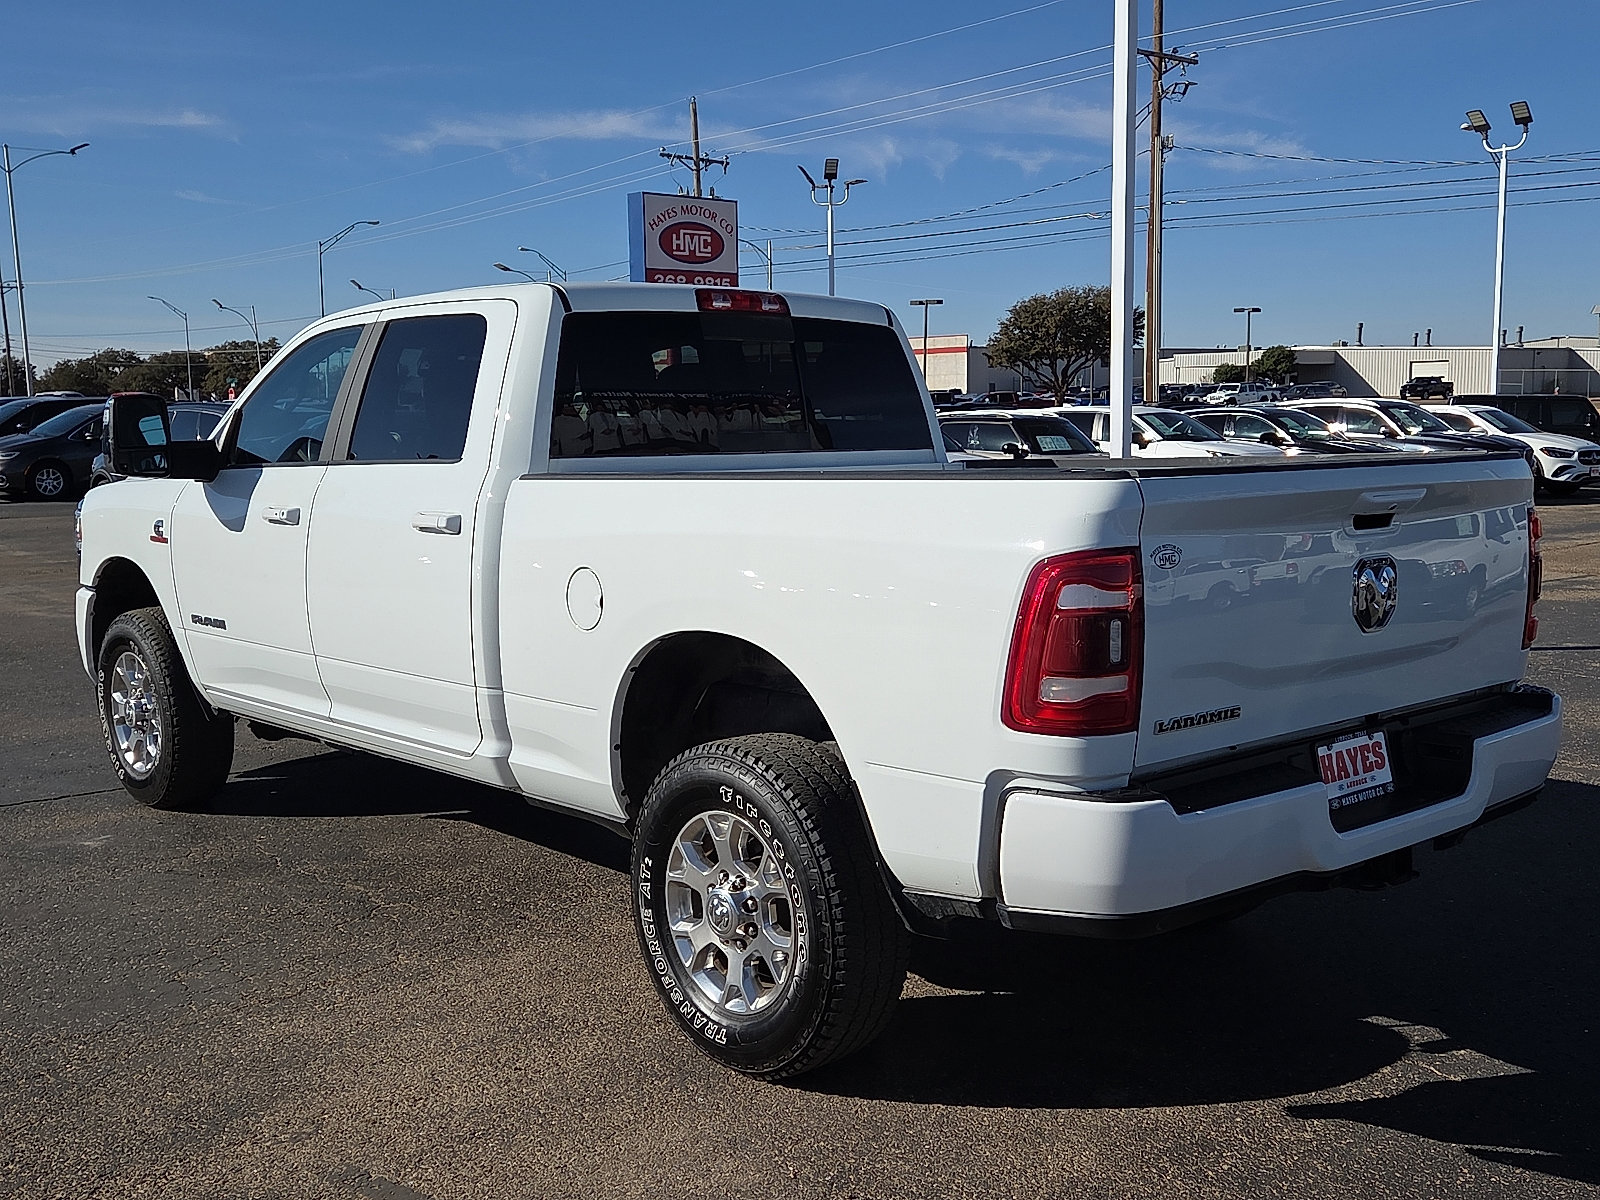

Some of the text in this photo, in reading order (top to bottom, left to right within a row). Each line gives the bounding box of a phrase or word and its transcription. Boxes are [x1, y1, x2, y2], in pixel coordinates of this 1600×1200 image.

[648, 204, 734, 238] HAYES MOTOR CO.
[672, 229, 712, 257] HMC
[1158, 551, 1177, 566] HMC
[190, 613, 227, 631] RAM
[1153, 704, 1242, 735] LARAMIE
[1319, 740, 1386, 786] HAYES
[1341, 794, 1358, 806] HAYES
[1358, 789, 1376, 802] MOTOR
[640, 908, 728, 1045] TRANSFORCE
